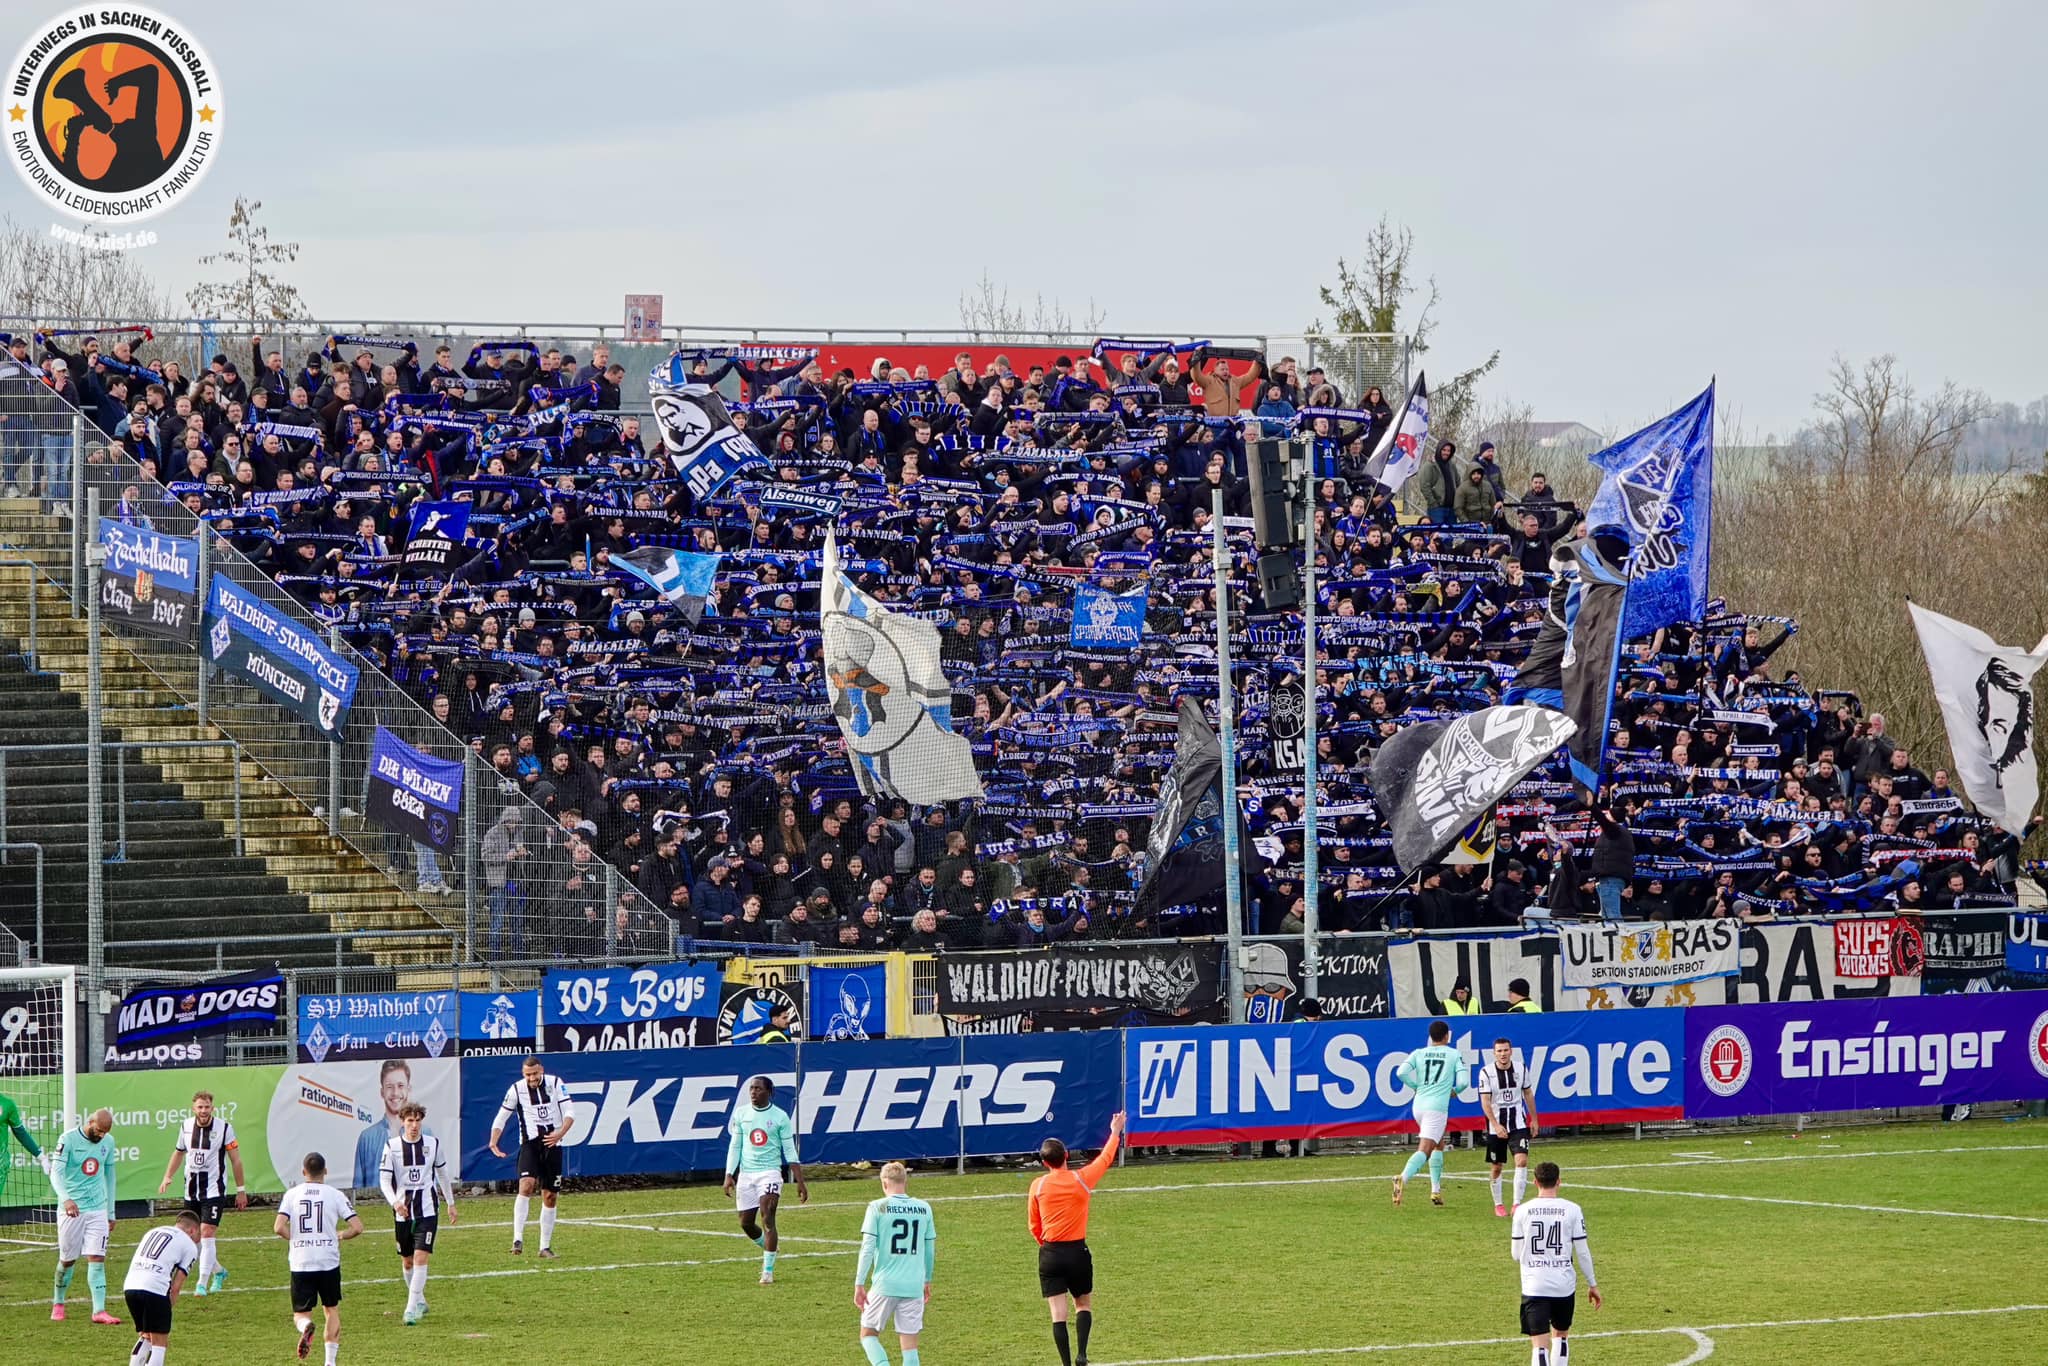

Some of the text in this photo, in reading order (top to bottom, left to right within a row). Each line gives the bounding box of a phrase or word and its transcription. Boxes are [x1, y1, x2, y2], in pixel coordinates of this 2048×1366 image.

[255, 487, 314, 505] SV WALDHOF
[763, 487, 838, 512] Alsenweg
[945, 554, 977, 568] Tradition
[152, 598, 185, 628] 1907
[245, 651, 306, 704] MÜNCHEN
[1722, 712, 1740, 720] APRIL
[1683, 764, 1721, 778] WLTER
[1567, 919, 1732, 966] ULT RAS
[1837, 921, 1890, 955] SUPS
[1591, 960, 1706, 978] SEKTION STADIONVERBOT
[1838, 953, 1890, 976] WORMS
[557, 969, 705, 1018] 305 Boys
[118, 984, 279, 1034] MAD DOGS
[307, 994, 448, 1021] SV Waldhof 07
[336, 1031, 420, 1054] Fan Club
[1777, 1020, 2007, 1086] Ensinger
[1210, 1030, 1671, 1114] IN-Sotware
[1423, 1059, 1445, 1086] 17
[301, 1085, 353, 1114] ratiopharm
[357, 1108, 373, 1124] teva
[764, 1182, 779, 1195] 32
[211, 1206, 218, 1219] 5
[299, 1199, 324, 1233] 21
[886, 1205, 927, 1216] RIECKMANN
[140, 1230, 174, 1260] 10
[294, 1239, 334, 1249] UZIN UTZ
[891, 1219, 920, 1255] 21
[1530, 1220, 1564, 1256] 24
[1528, 1259, 1571, 1268] UZIN UTZ
